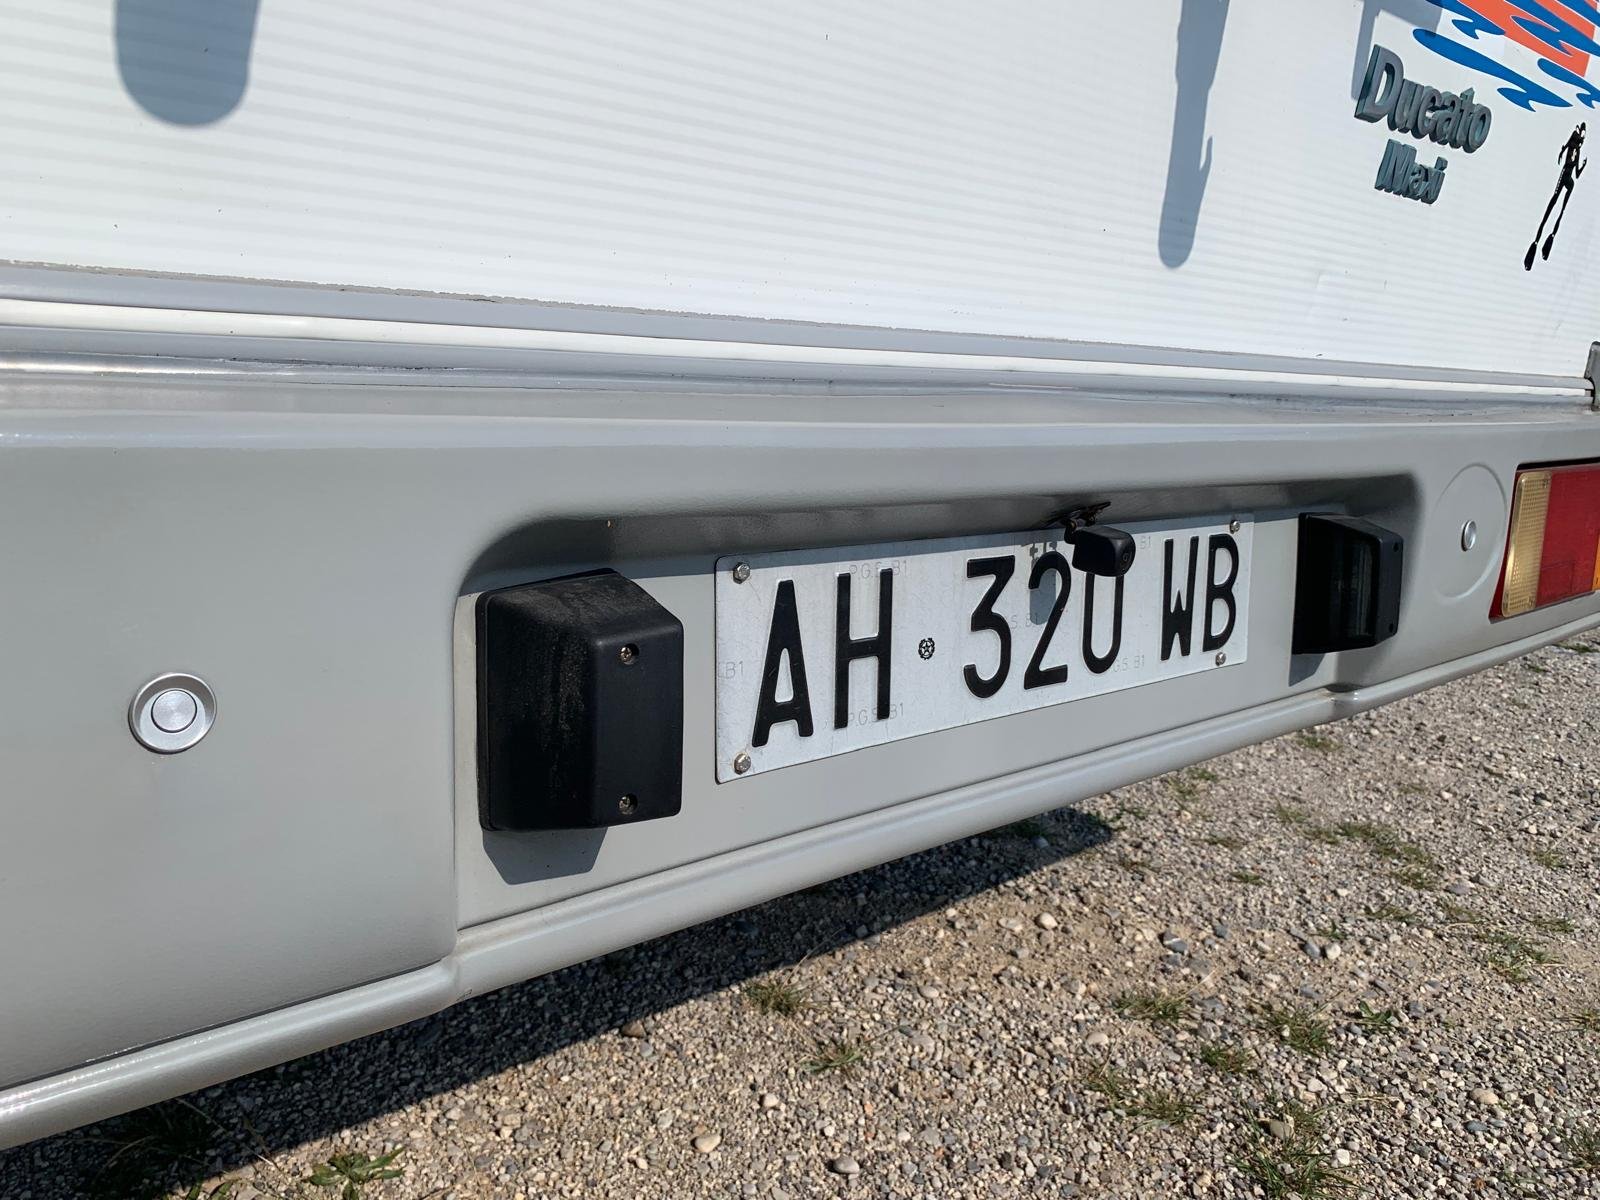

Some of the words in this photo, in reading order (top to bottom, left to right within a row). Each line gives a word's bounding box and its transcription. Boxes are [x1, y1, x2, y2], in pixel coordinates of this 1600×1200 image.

[1355, 44, 1491, 153] Ducato
[1375, 139, 1448, 204] Maxi
[752, 568, 893, 747] AH
[963, 550, 1124, 698] 320
[1160, 533, 1239, 661] WB
